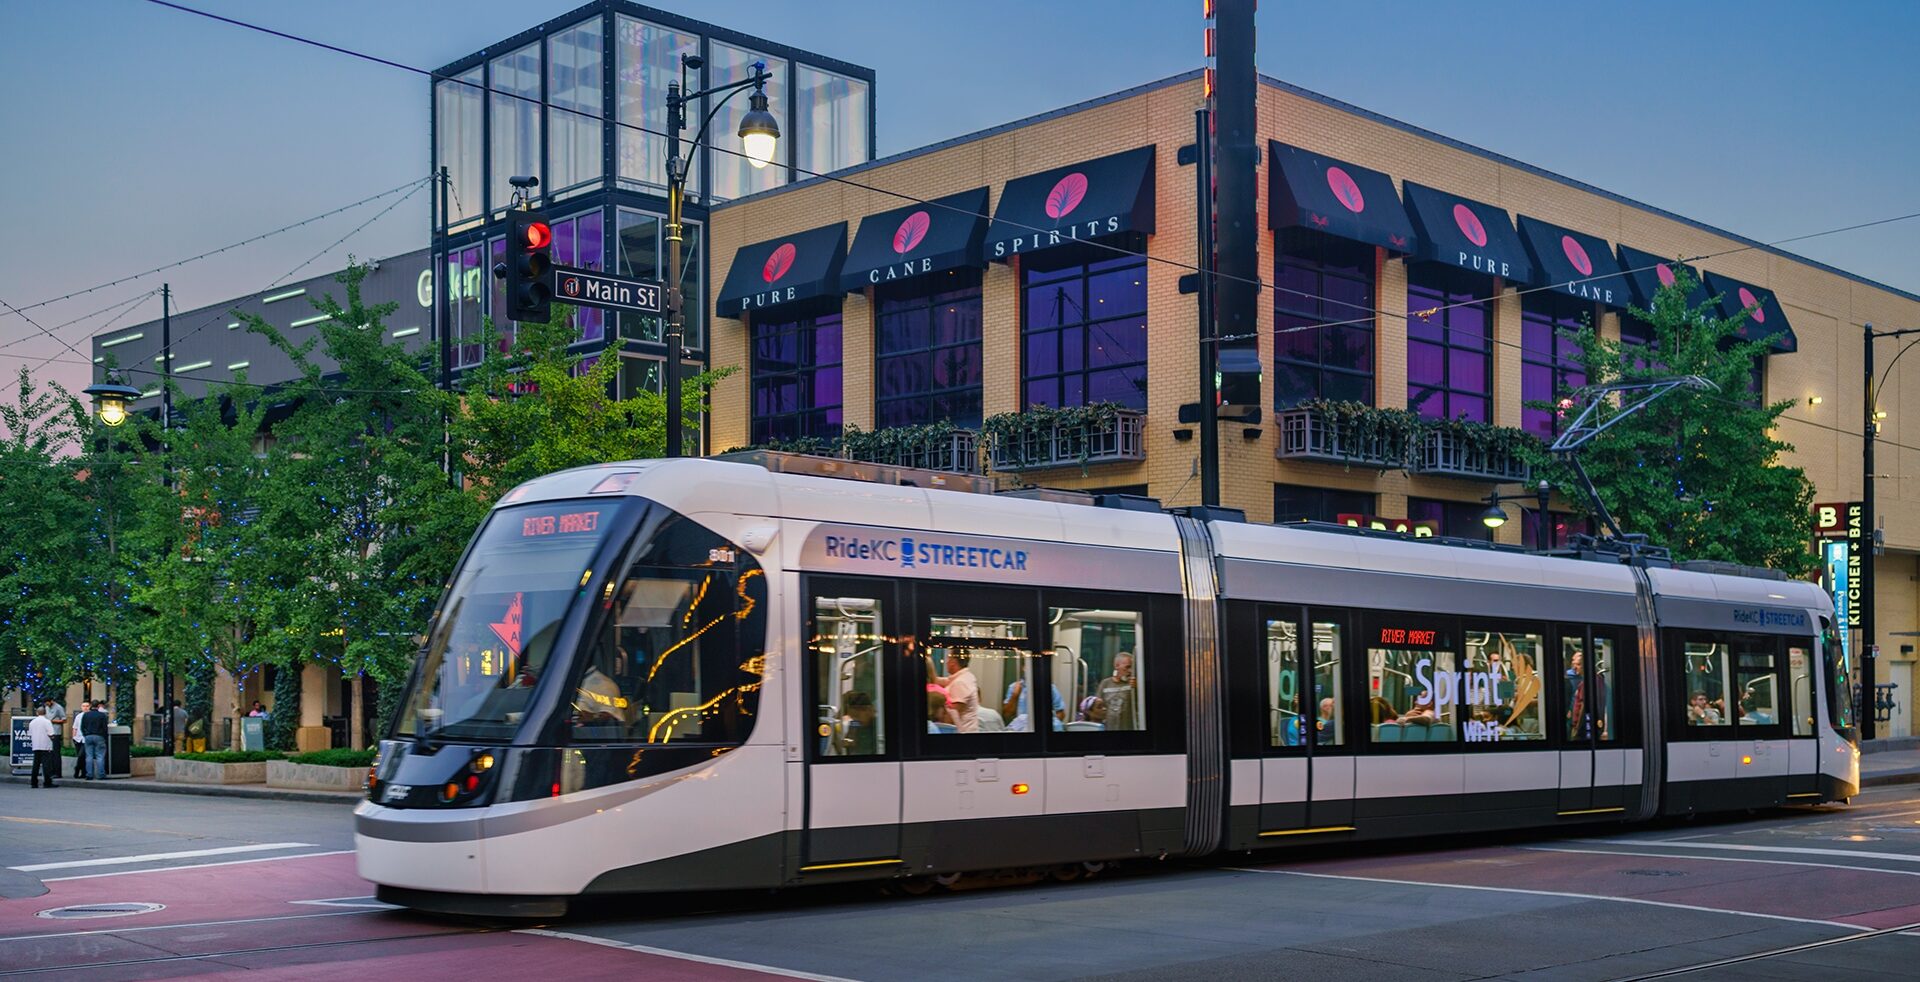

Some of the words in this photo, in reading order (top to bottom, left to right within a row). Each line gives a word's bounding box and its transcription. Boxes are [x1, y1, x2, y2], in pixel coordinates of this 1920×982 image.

[994, 216, 1119, 257] SPIRITS
[870, 258, 932, 283] CANE
[1459, 252, 1510, 277] PURE
[586, 279, 631, 304] Main
[637, 287, 656, 308] St
[742, 287, 796, 310] PURE
[1568, 281, 1613, 303] CANE
[522, 516, 555, 536] RIVER
[559, 511, 600, 533] MARKET
[1848, 506, 1861, 538] BAR
[709, 549, 735, 563] 801
[825, 536, 897, 561] RideKC
[918, 543, 1028, 571] STREETCAR
[1848, 555, 1861, 626] KITCHEN
[1734, 609, 1759, 624] RideKC
[1765, 611, 1805, 626] STREETCAR
[1381, 628, 1406, 644] RIVER
[1408, 630, 1436, 646] MARKET
[1416, 658, 1503, 720] Sprint
